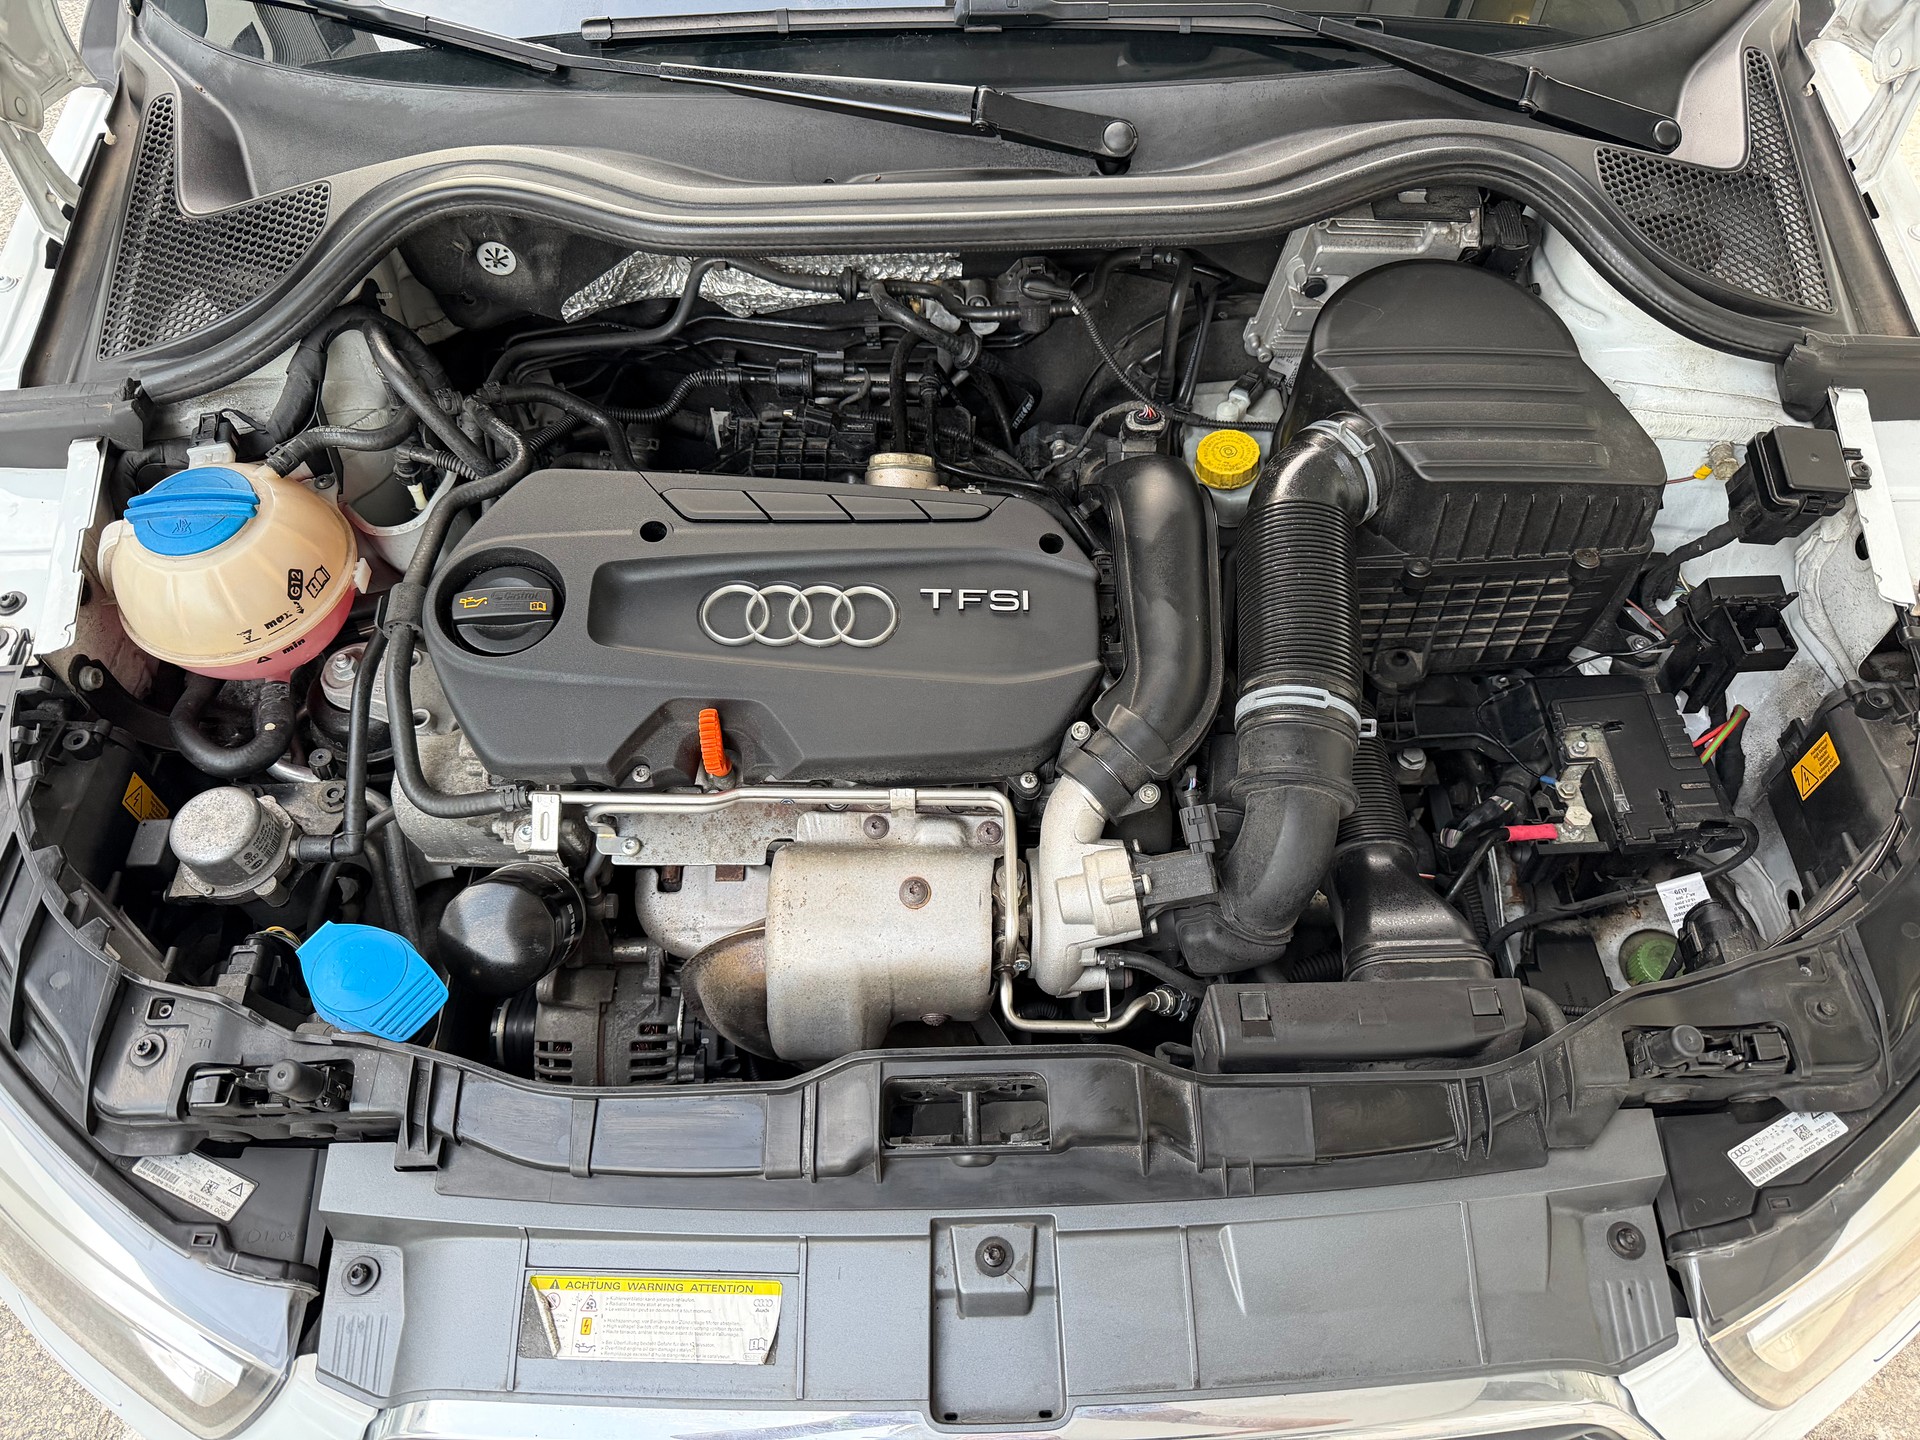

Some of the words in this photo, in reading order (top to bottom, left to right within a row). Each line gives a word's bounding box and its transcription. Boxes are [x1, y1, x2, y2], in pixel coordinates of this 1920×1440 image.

[290, 570, 301, 596] G12
[920, 588, 1029, 611] TFSI
[282, 638, 306, 654] min
[565, 1281, 621, 1290] ACHTUNG
[627, 1282, 684, 1292] WARNING
[690, 1284, 754, 1293] ATTENTION
